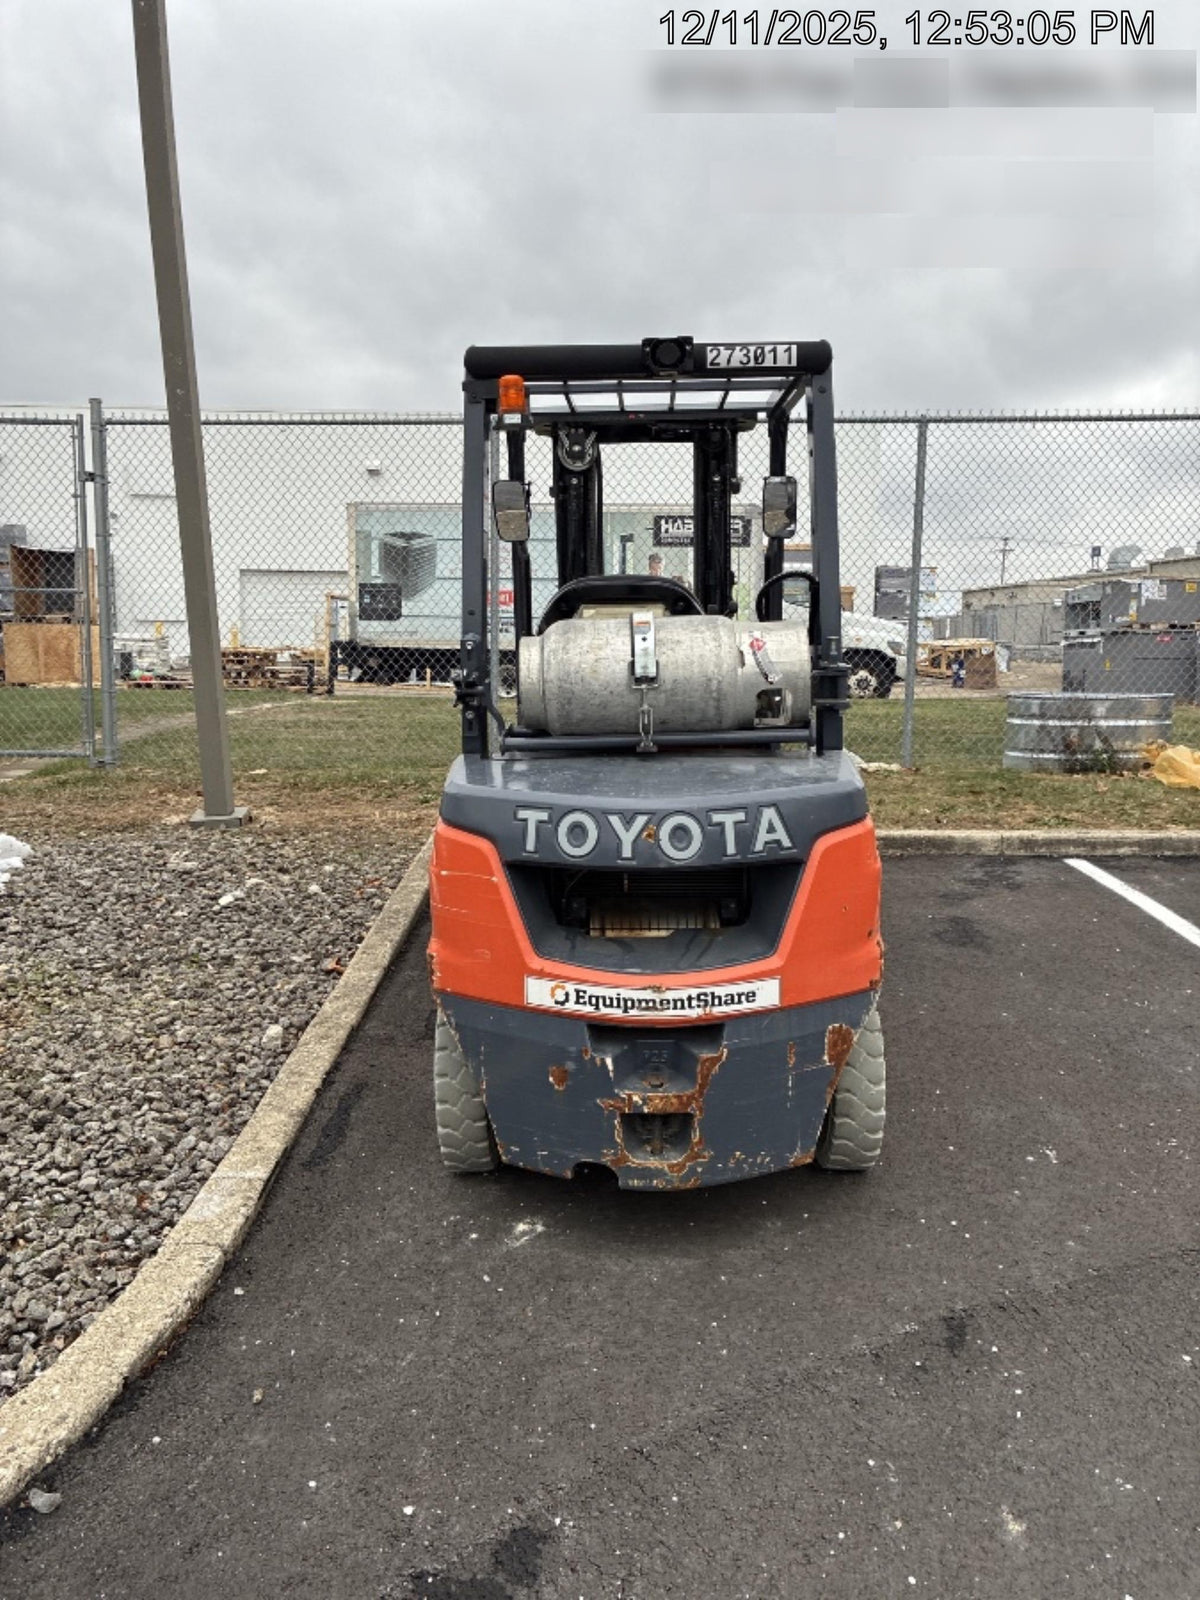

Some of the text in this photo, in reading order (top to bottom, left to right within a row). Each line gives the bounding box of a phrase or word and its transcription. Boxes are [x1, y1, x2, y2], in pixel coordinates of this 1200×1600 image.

[708, 345, 793, 366] 273011
[515, 805, 793, 861] TOYOTA
[573, 987, 757, 1014] EquipmentShare
